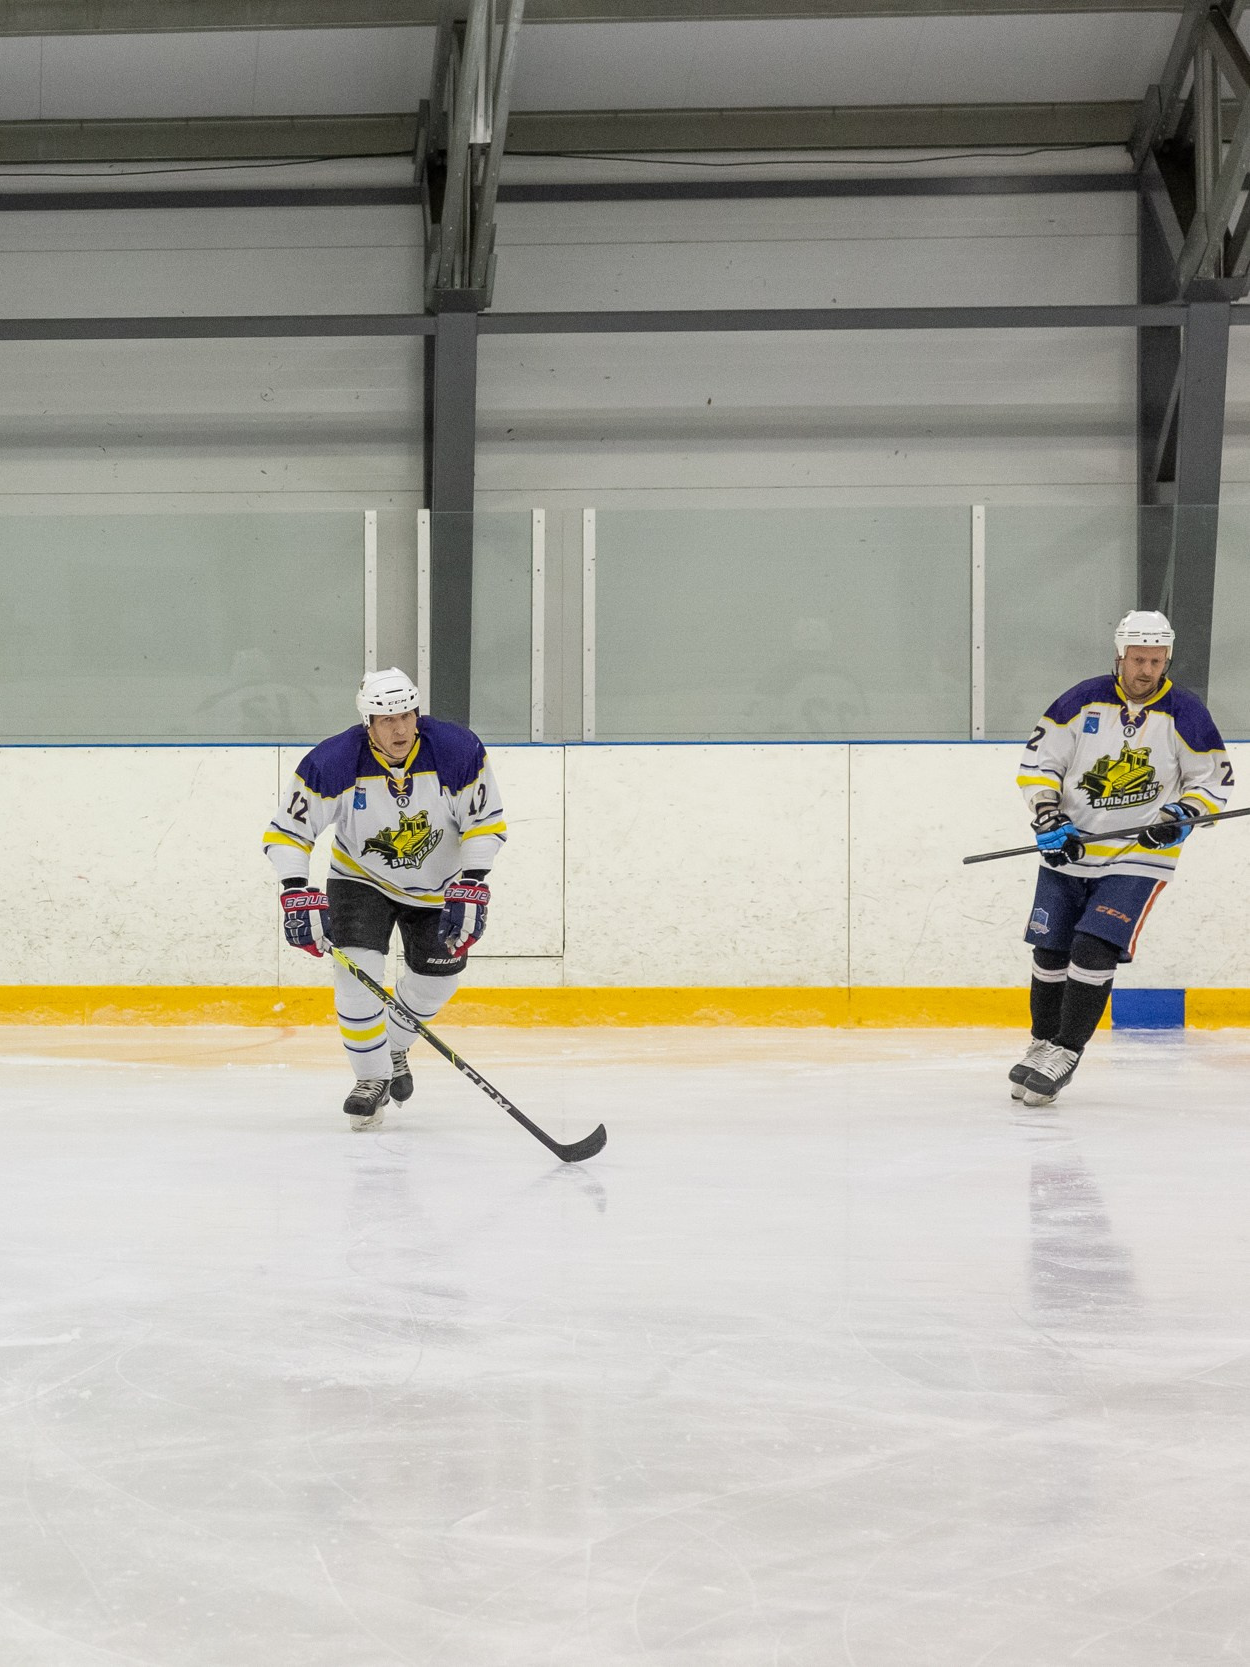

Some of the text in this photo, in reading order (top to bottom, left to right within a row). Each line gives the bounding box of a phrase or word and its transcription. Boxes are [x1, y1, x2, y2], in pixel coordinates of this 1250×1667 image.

[388, 698, 407, 706] CCM
[1025, 725, 1046, 751] 2
[1220, 761, 1235, 787] 2
[286, 790, 309, 825] 12
[468, 783, 487, 817] 12
[1093, 789, 1156, 807] БУЛЬДОЗЕР
[1095, 904, 1132, 923] CCM
[461, 1065, 512, 1112] CCM
